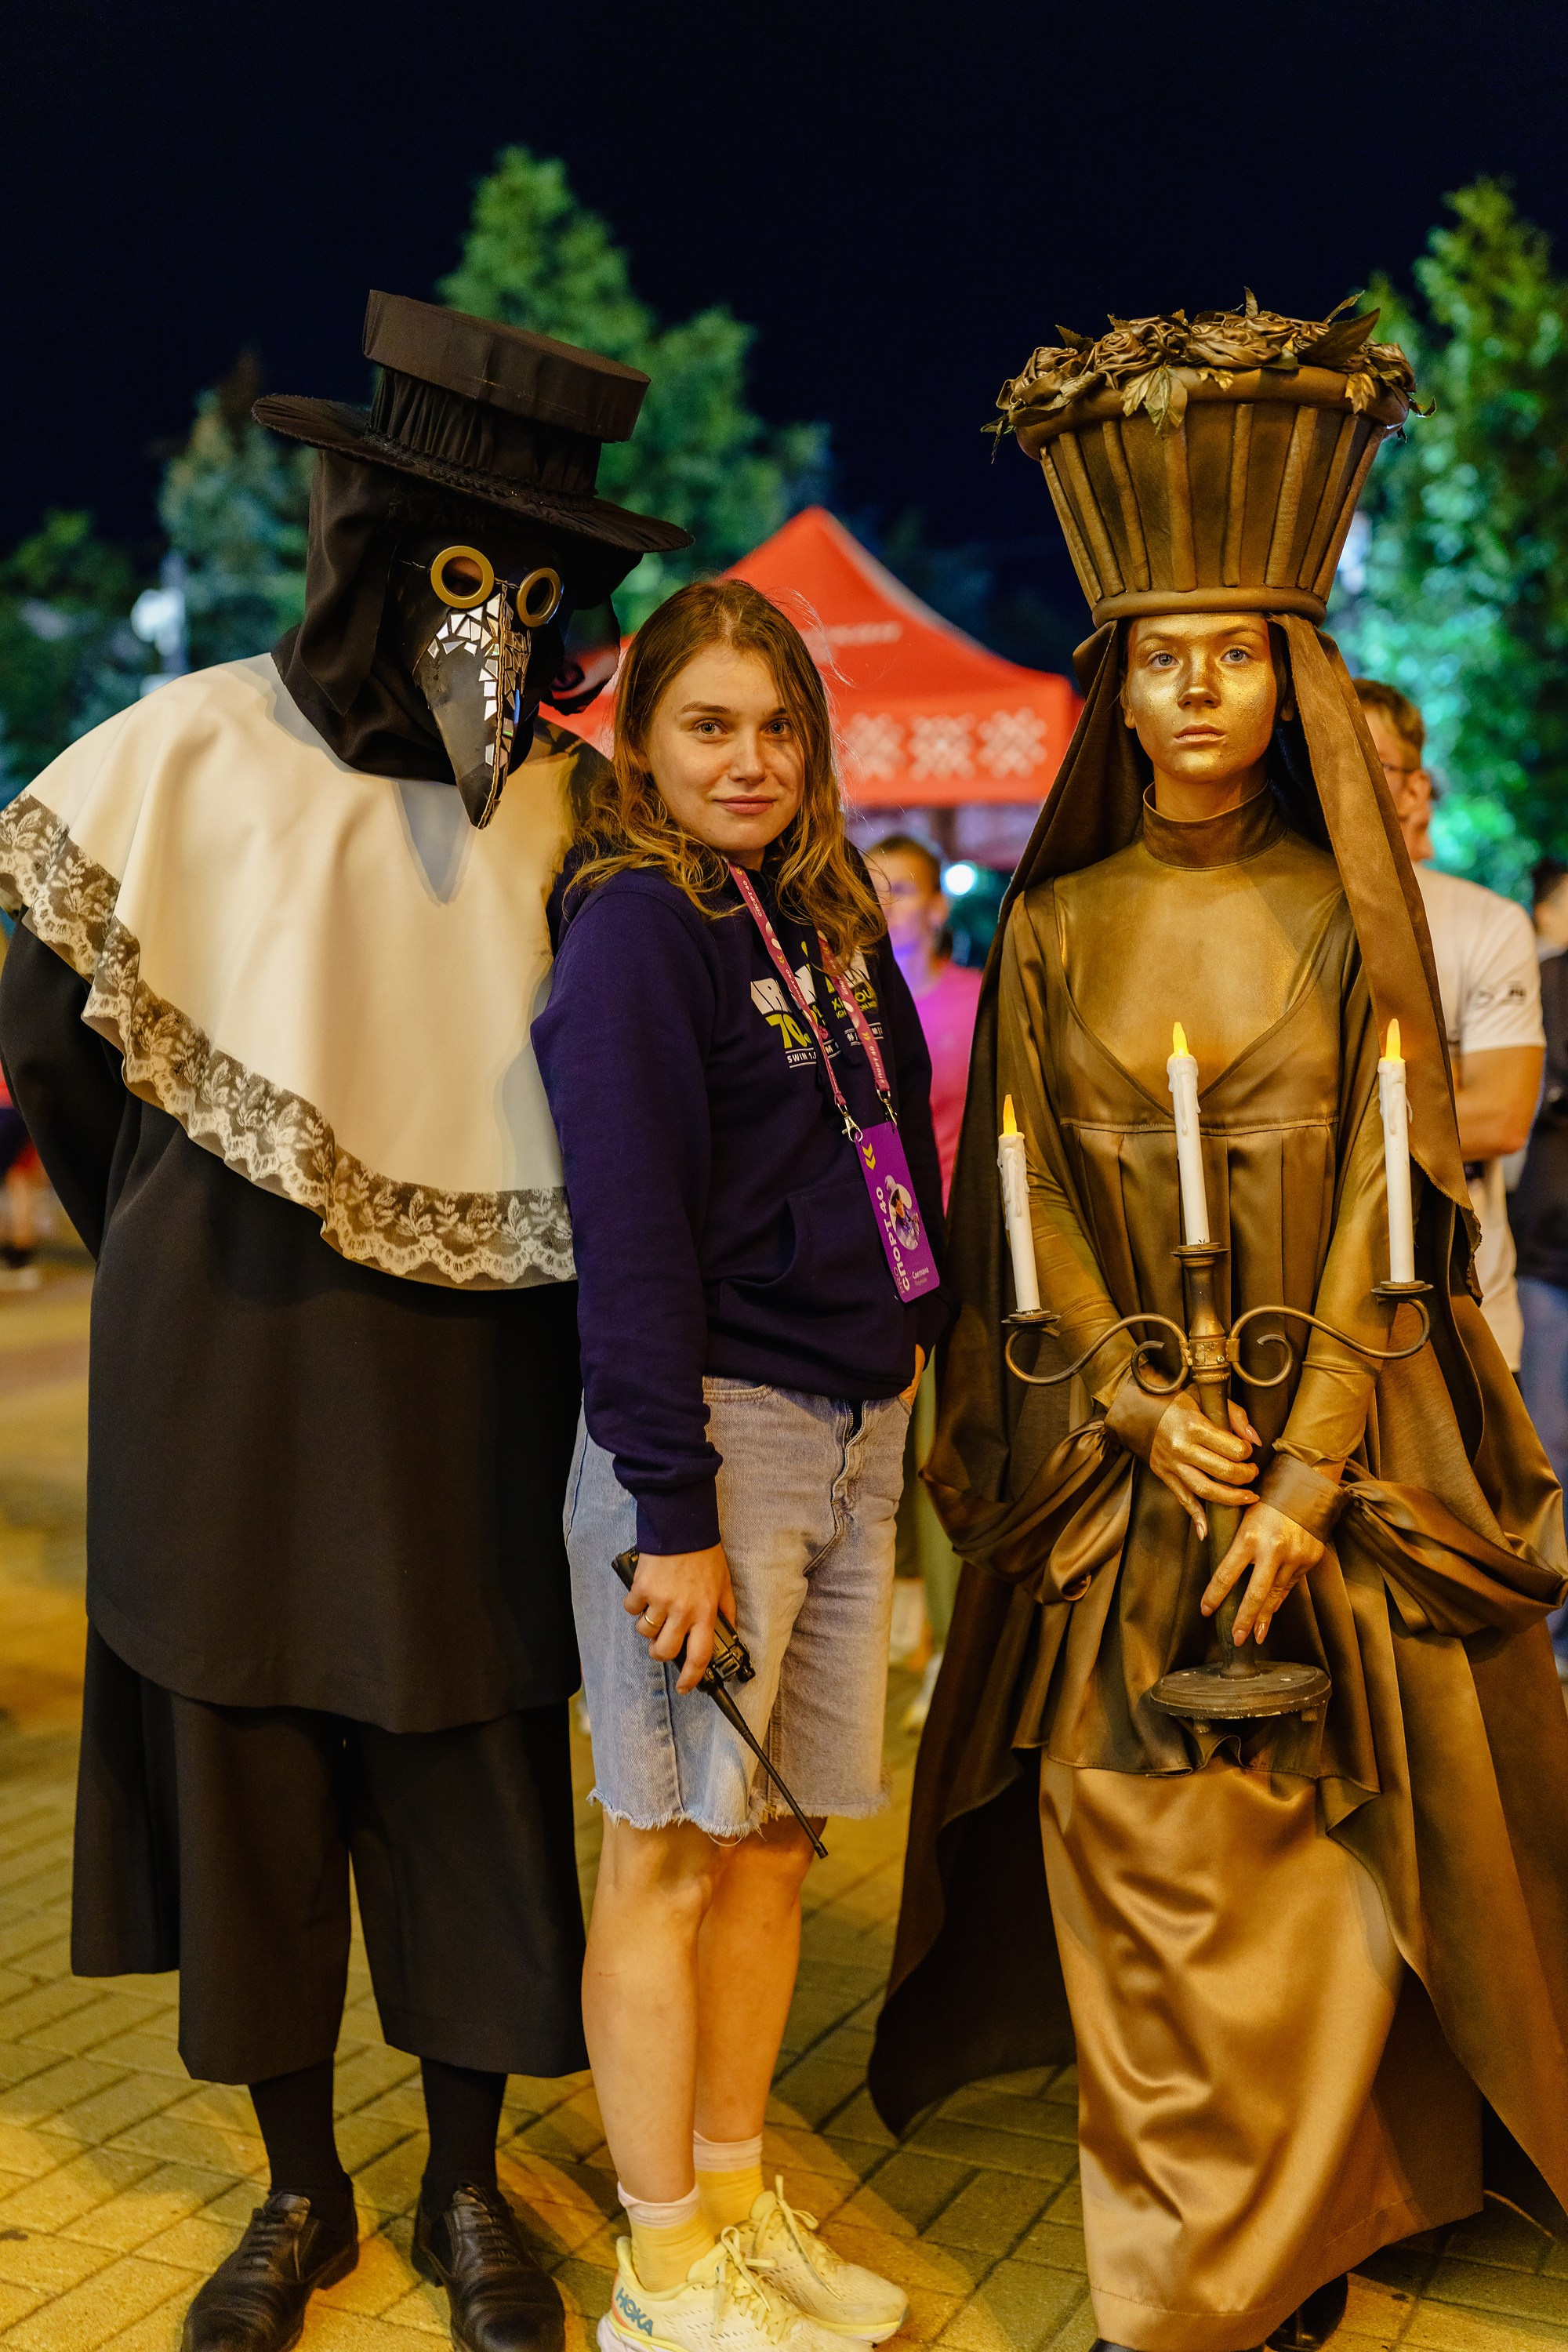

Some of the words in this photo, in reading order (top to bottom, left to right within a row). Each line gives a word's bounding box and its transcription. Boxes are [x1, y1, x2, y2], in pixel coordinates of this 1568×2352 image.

[787, 1051, 808, 1064] SWIM
[877, 1186, 887, 1214] 40
[884, 1219, 909, 1290] СПОРТ
[615, 2287, 653, 2336] HOKA
